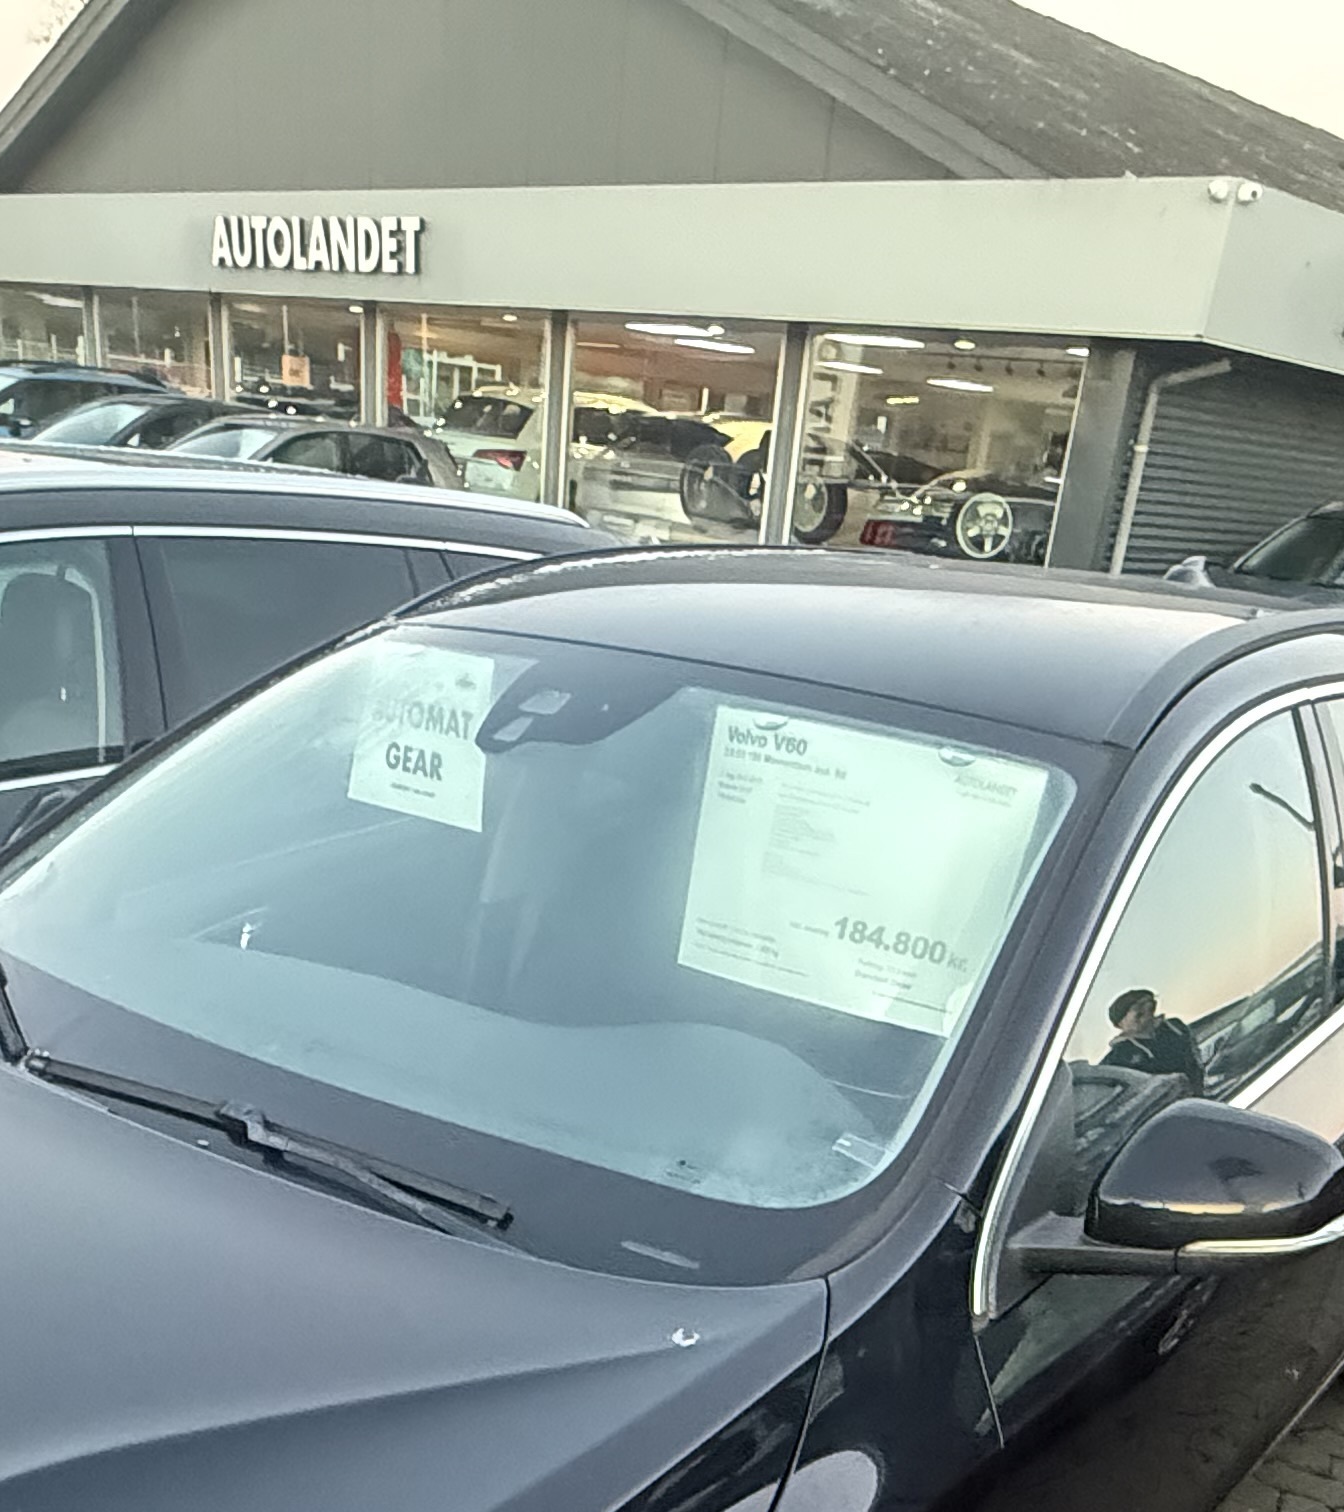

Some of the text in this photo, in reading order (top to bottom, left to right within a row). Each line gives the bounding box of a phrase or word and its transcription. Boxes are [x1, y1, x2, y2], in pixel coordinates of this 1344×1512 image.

[211, 214, 422, 275] AUTOLANDET
[385, 741, 443, 781] GEAR
[727, 725, 768, 748] Volvo
[773, 733, 809, 756] V60
[834, 916, 948, 964] 184.800
